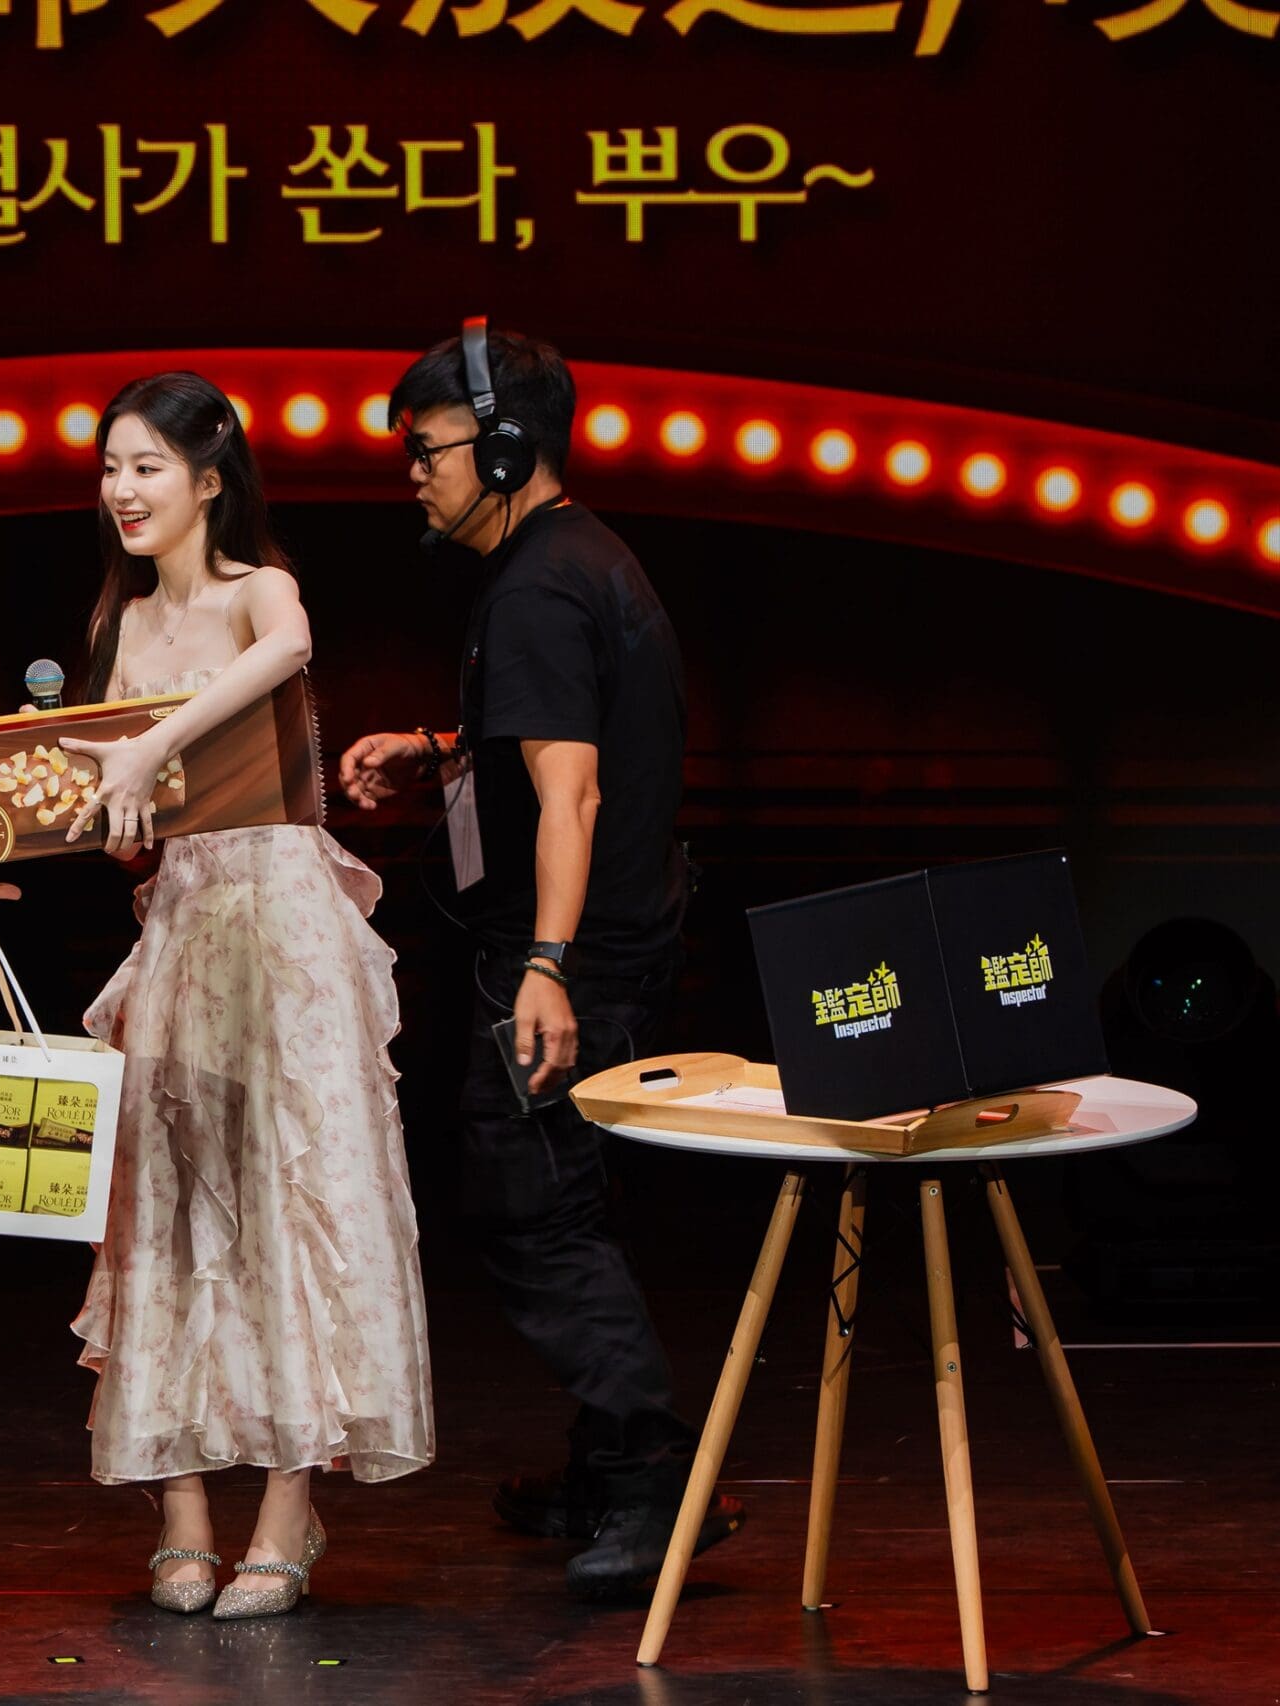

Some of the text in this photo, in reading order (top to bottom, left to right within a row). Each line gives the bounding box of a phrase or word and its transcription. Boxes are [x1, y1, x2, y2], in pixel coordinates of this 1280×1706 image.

[281, 122, 535, 250] 쏜다,
[576, 124, 874, 242] 뿌우~
[981, 944, 1054, 991] 鑑定師
[812, 971, 902, 1026] 鑑定師
[999, 984, 1047, 1008] Inspector
[834, 1012, 892, 1039] Inspector
